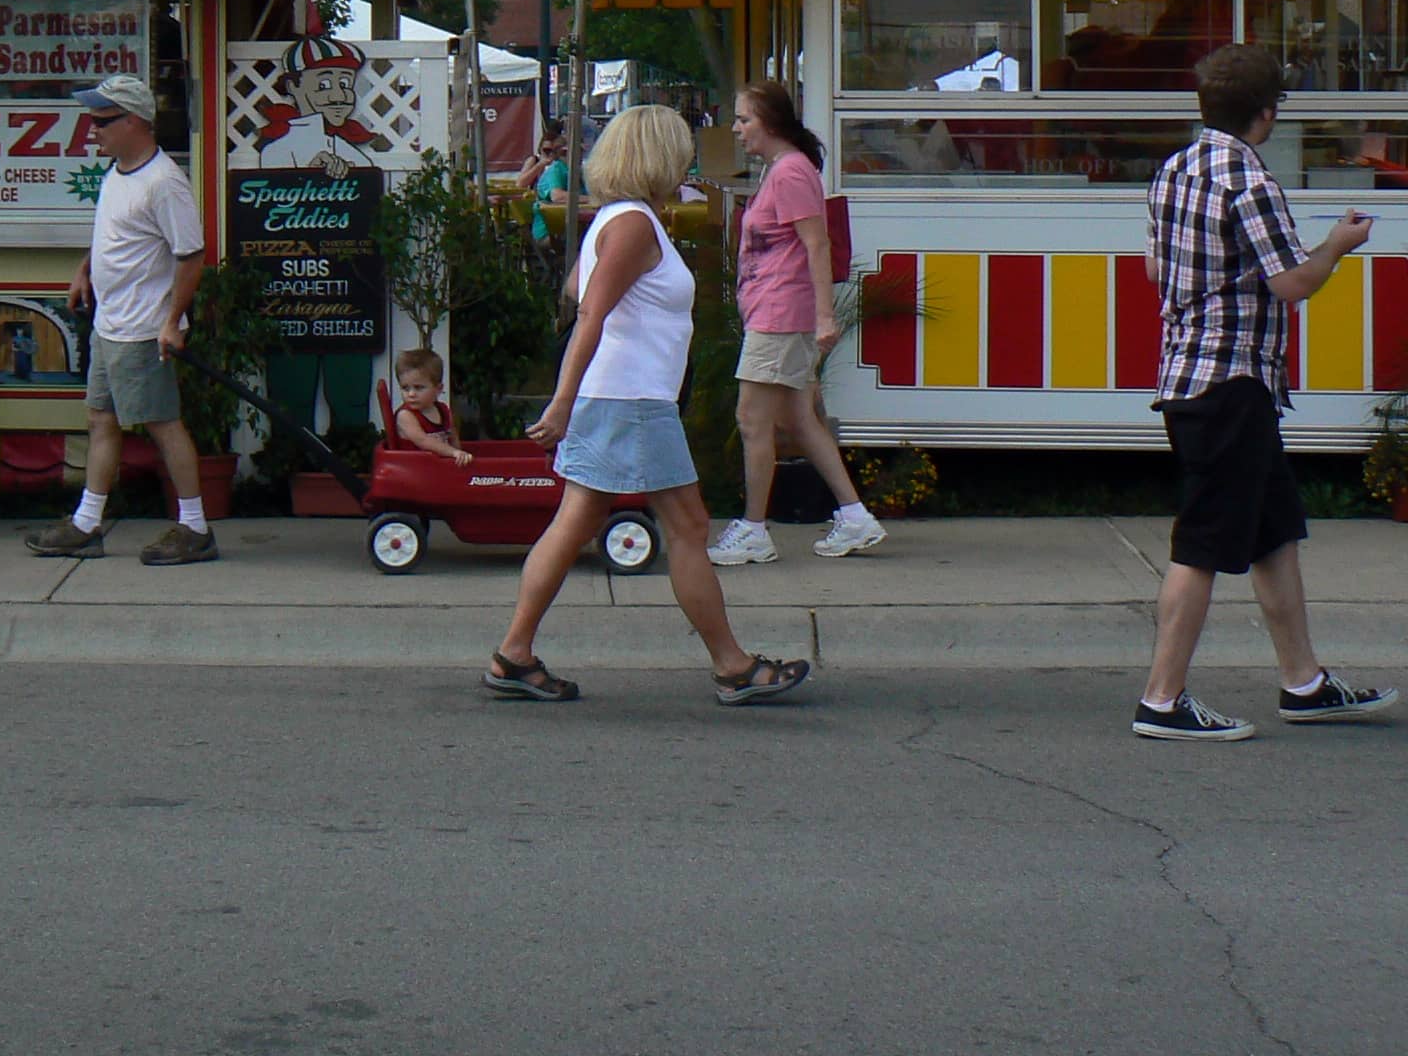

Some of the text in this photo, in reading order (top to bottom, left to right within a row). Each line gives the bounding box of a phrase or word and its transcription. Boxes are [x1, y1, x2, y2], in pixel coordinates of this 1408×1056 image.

[4, 168, 57, 183] CHEESE
[238, 180, 360, 208] Spaghetti
[264, 207, 350, 232] Eddies
[240, 240, 318, 256] PIZZA
[281, 259, 330, 277] SUBS
[313, 319, 374, 337] SHELLS
